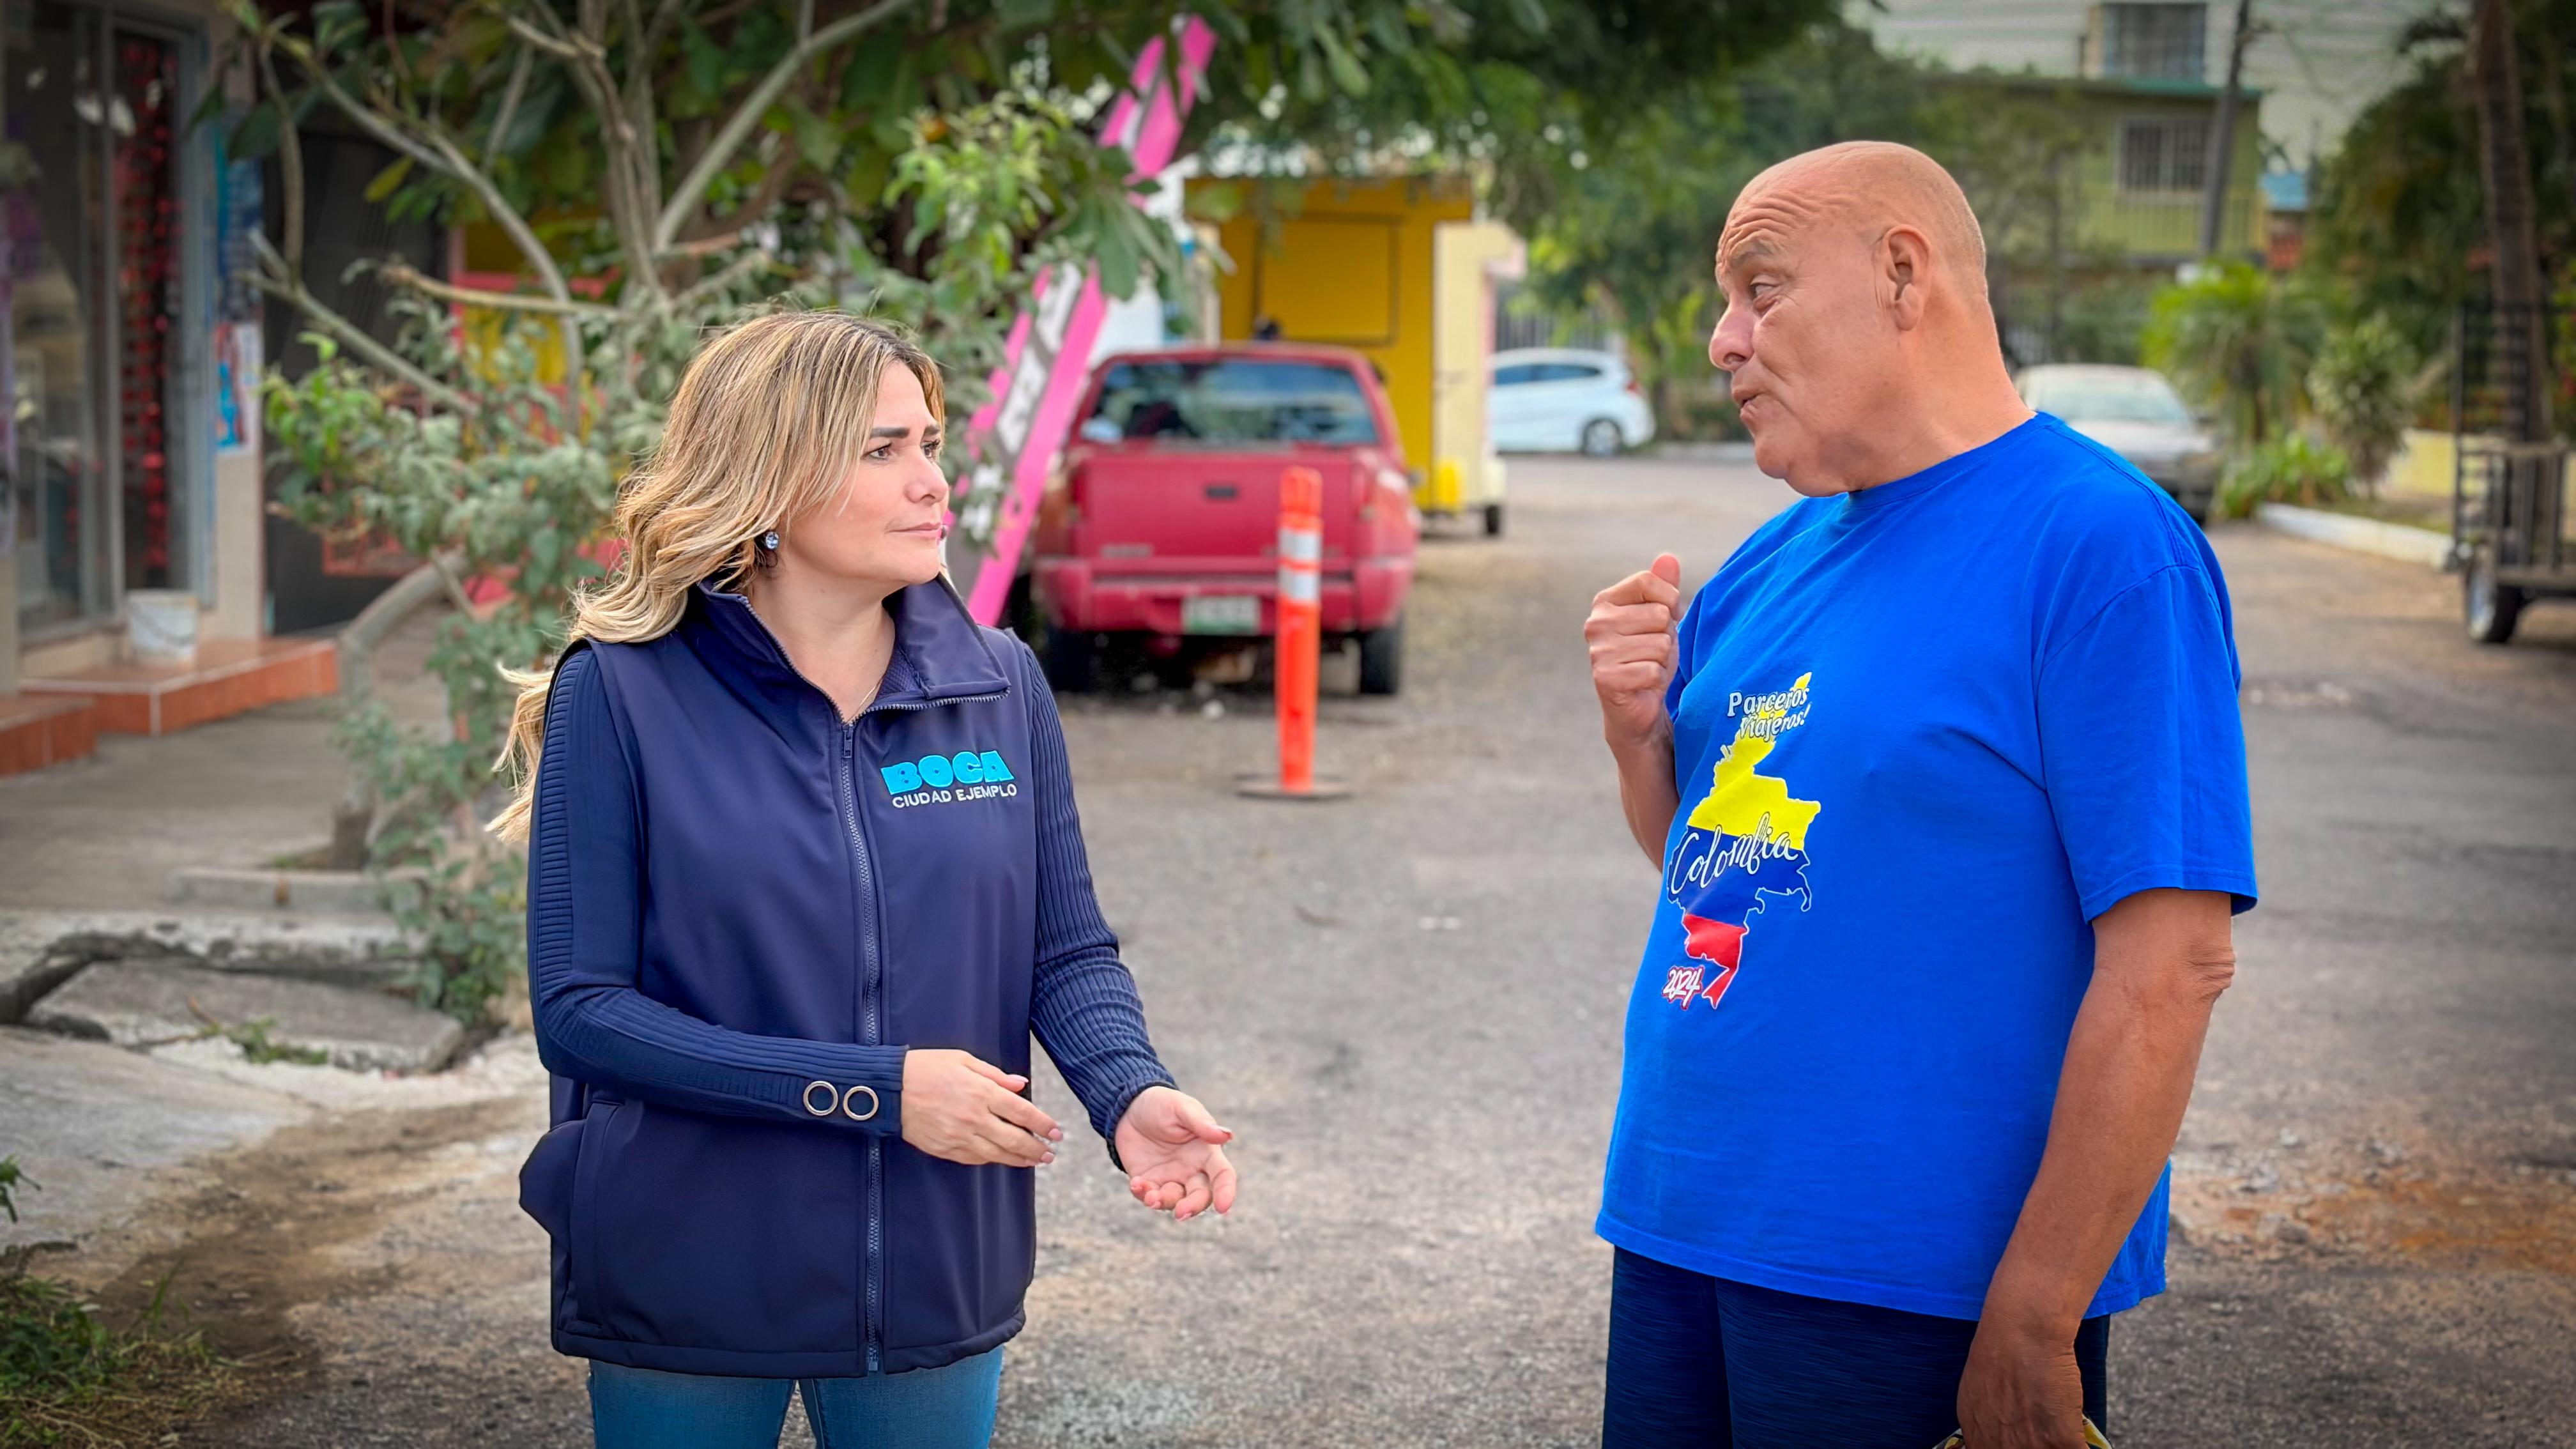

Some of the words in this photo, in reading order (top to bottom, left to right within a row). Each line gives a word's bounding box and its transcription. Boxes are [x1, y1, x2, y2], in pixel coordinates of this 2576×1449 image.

[1727, 687, 1810, 717] Parceros
[1740, 702, 1812, 742] Viajeros!
[880, 750, 1015, 795] BOCA
[892, 790, 952, 808] CIUDAD
[955, 783, 1017, 801] EJEMPLO
[1671, 811, 1799, 894] Colombia
[1662, 968, 1702, 1007] 2024
